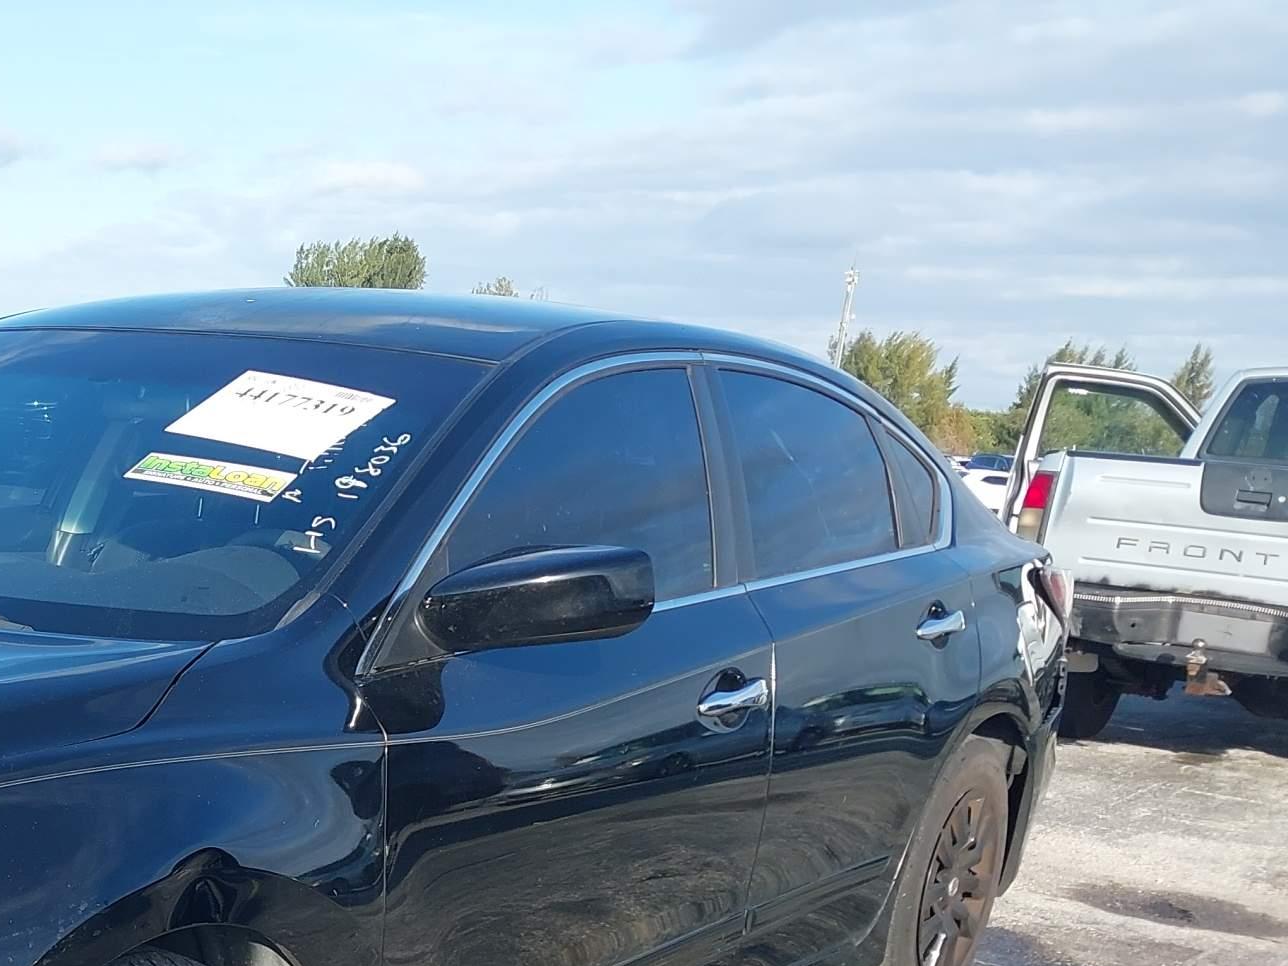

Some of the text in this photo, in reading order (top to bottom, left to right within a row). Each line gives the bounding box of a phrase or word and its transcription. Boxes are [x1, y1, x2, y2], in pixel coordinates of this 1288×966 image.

[235, 387, 356, 416] 44177319
[138, 456, 287, 491] InstaLoan
[1116, 537, 1280, 565] FRONT
